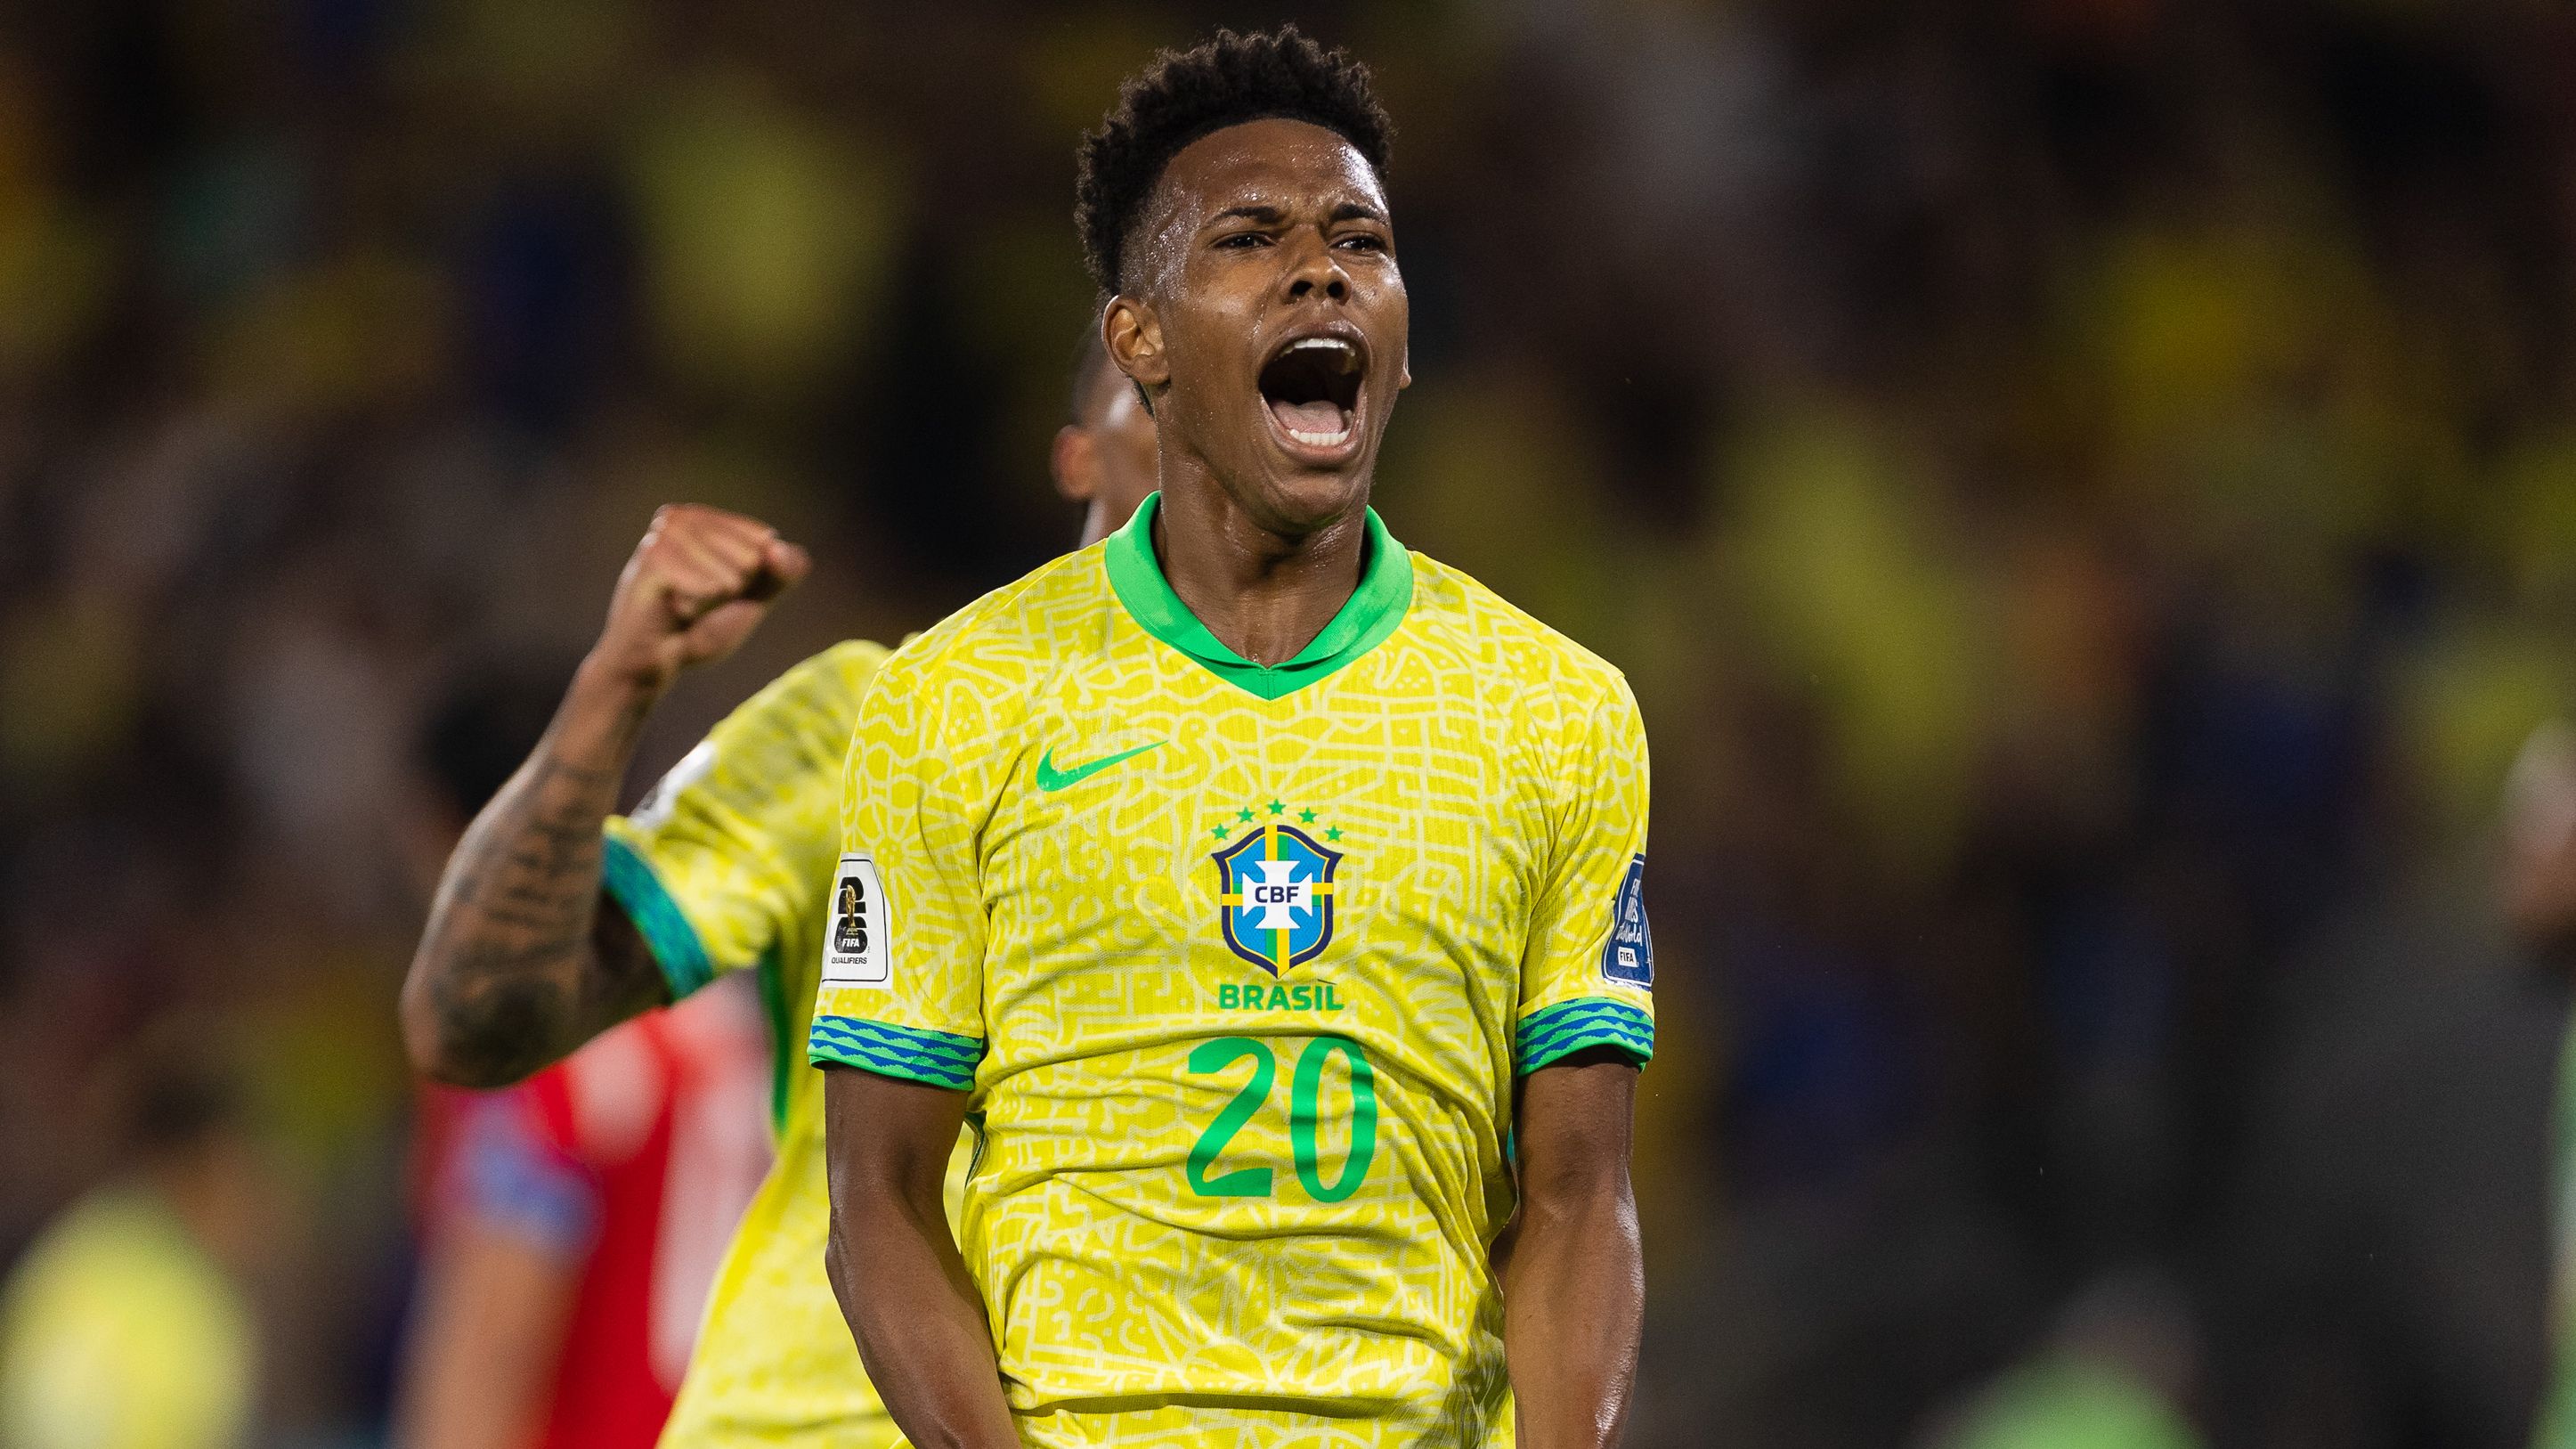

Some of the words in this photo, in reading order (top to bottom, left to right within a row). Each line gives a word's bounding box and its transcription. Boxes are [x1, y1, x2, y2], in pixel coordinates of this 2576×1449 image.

[1255, 885, 1300, 904] CBF
[842, 938, 860, 948] FIFA
[1620, 951, 1634, 963] FIFA
[1219, 983, 1345, 1012] BRASIL
[1186, 1035, 1377, 1203] 20
